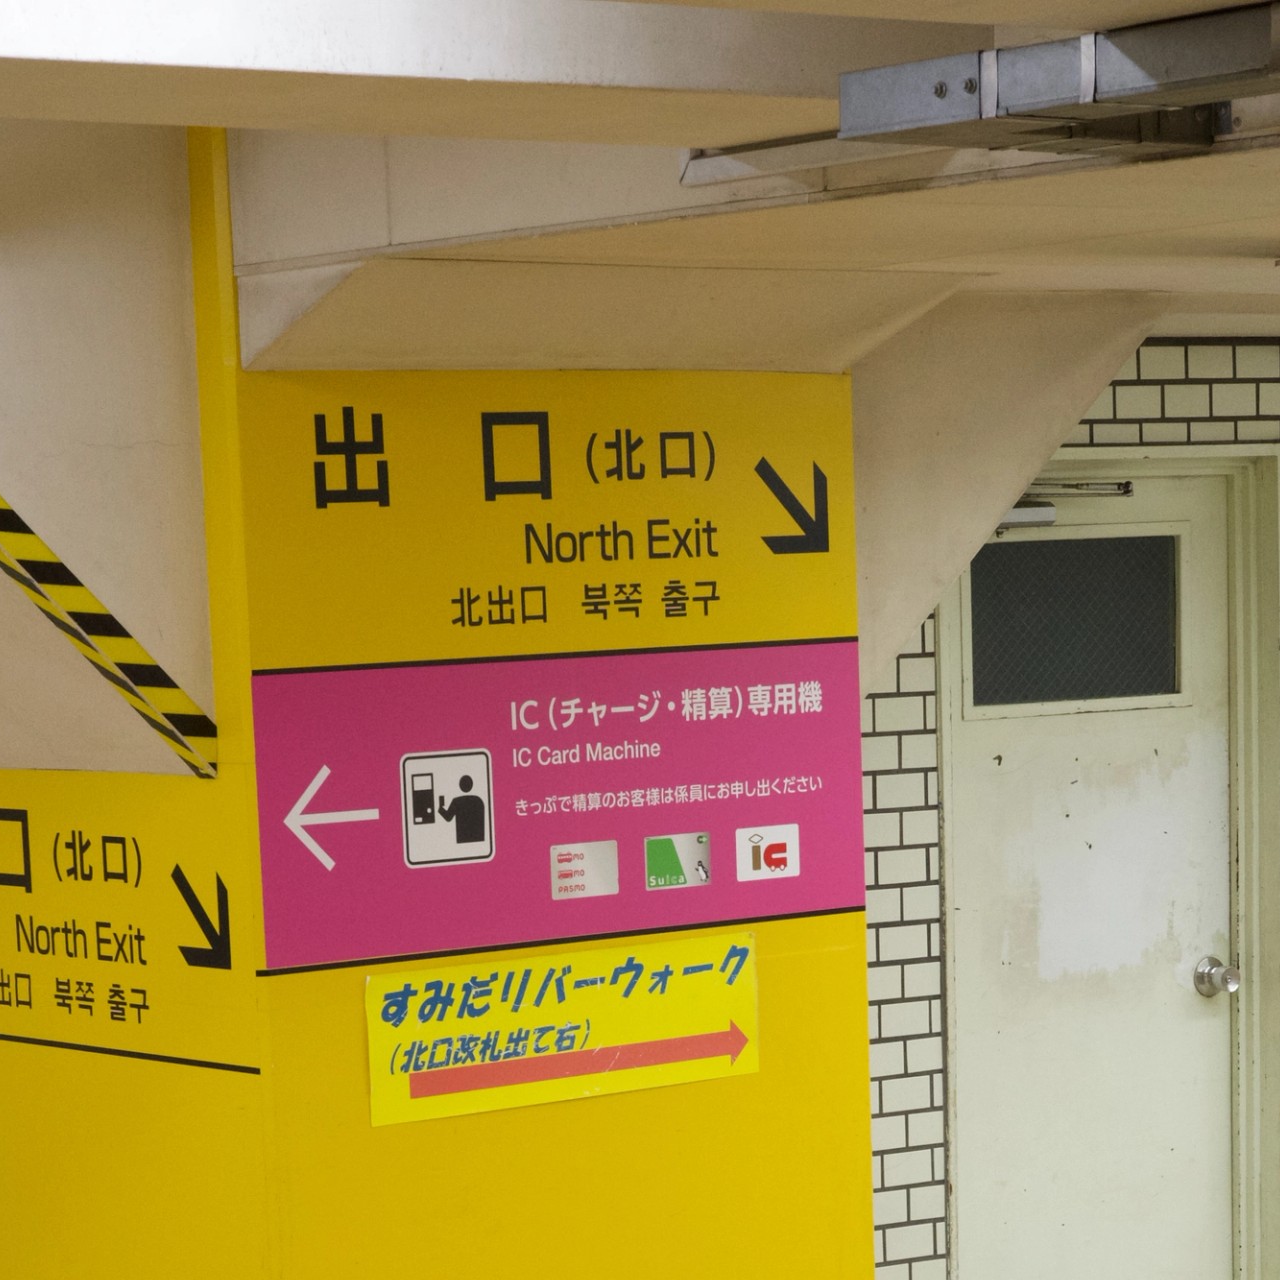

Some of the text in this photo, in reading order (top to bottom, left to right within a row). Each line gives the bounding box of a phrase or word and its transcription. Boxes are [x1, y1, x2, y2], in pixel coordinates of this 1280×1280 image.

[524, 518, 719, 565] North Exit
[451, 580, 720, 628] 北出口 북쪽 출구
[512, 739, 661, 768] IC Card Machine
[515, 775, 823, 818] きっぷで精算のお客様は係員にお申し出ください
[558, 884, 586, 894] PASMO
[649, 874, 686, 887] Suica
[15, 913, 148, 966] North Exit
[54, 976, 95, 1016] 북쪽
[107, 983, 150, 1024] 출구
[381, 944, 750, 1028] すみだリバーウォーク
[389, 1019, 592, 1076] (北口改札出て右)
